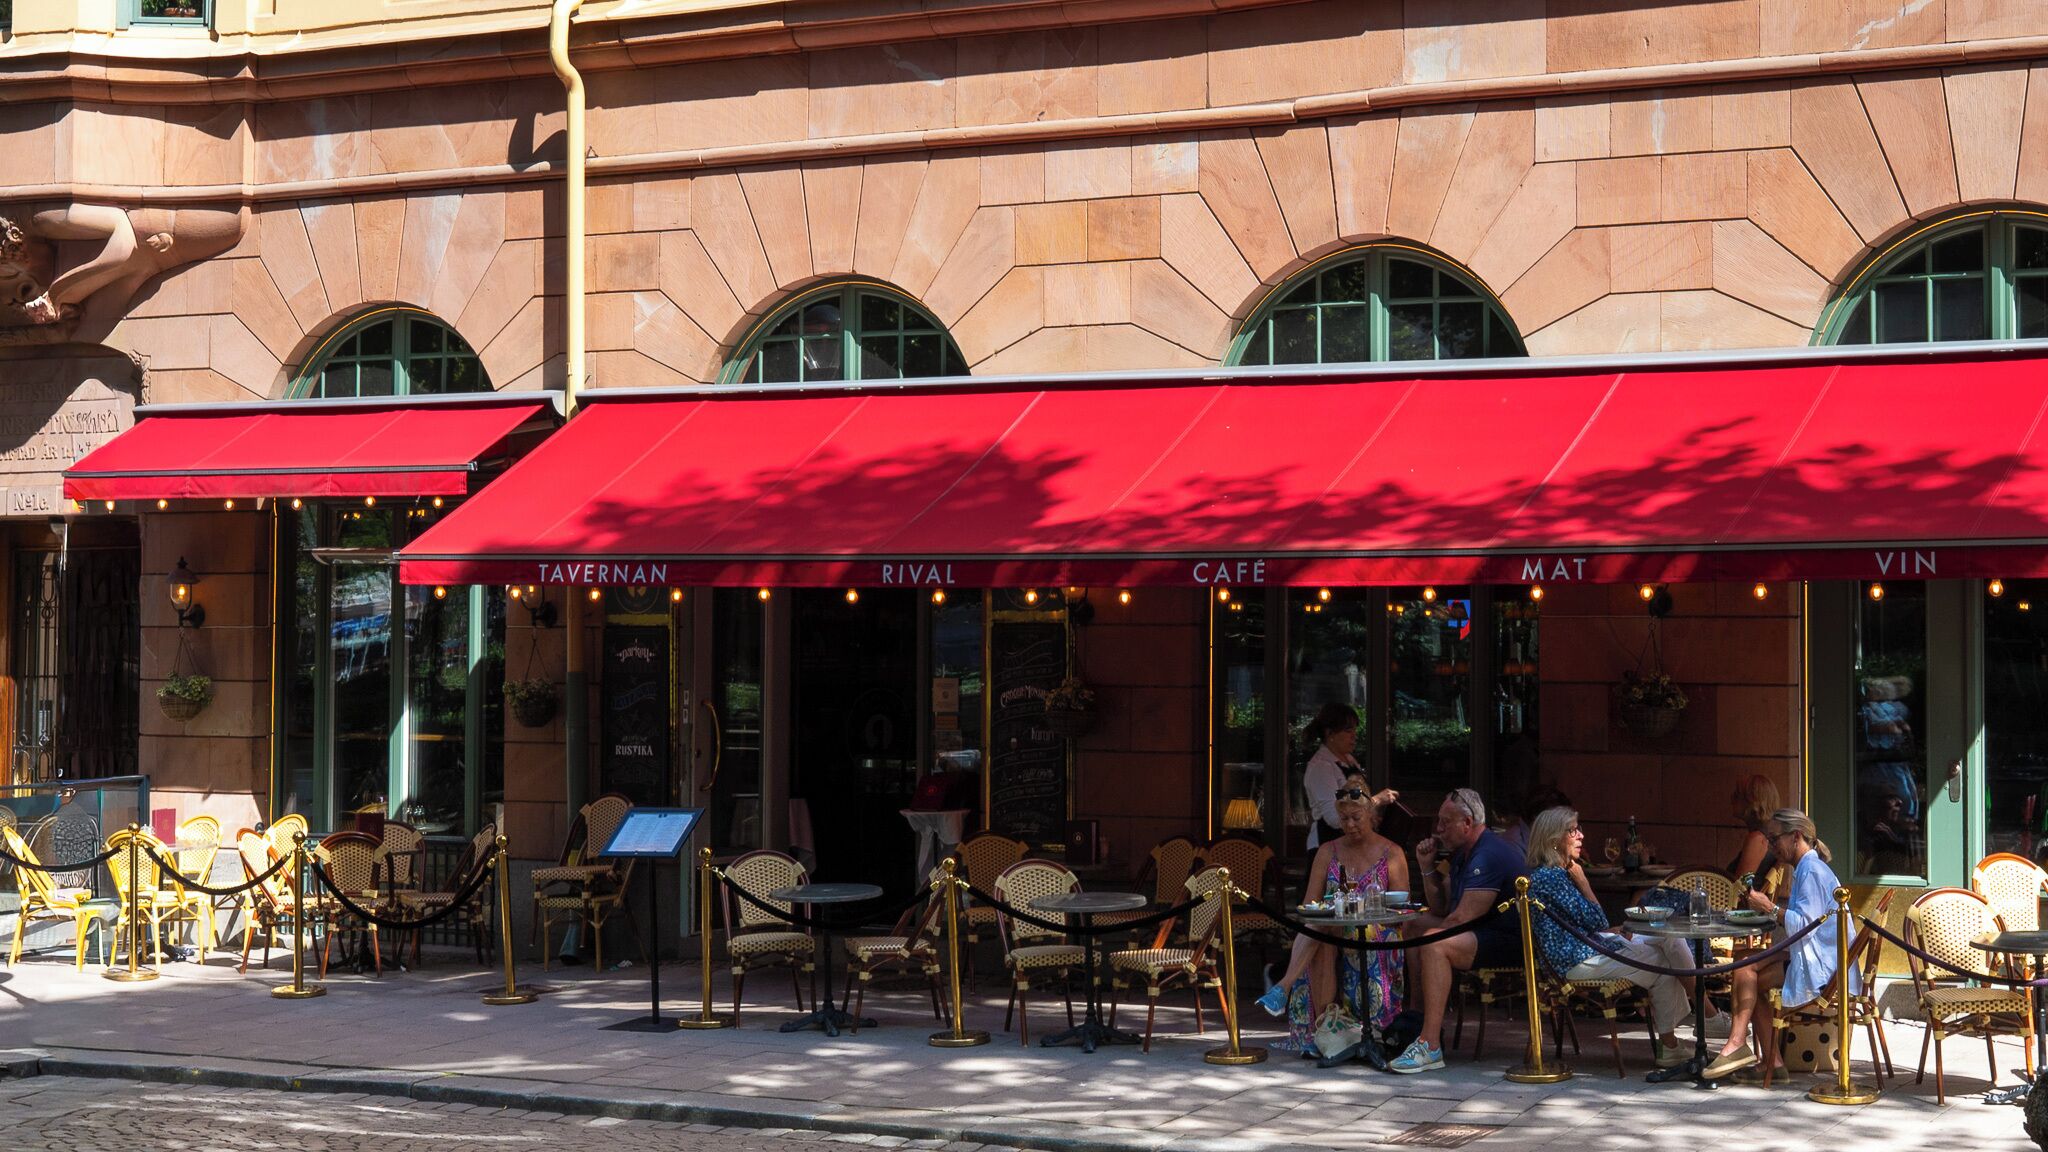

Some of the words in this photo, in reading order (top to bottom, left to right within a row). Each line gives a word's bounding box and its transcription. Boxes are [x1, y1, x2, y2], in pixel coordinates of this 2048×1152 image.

[538, 564, 668, 583] TAVERNAN
[1193, 559, 1265, 583] CAFÉ
[1521, 558, 1586, 581] MAT
[1875, 551, 1937, 575] VIN
[882, 564, 955, 584] RIVAL
[615, 744, 654, 757] RUSTIKA
